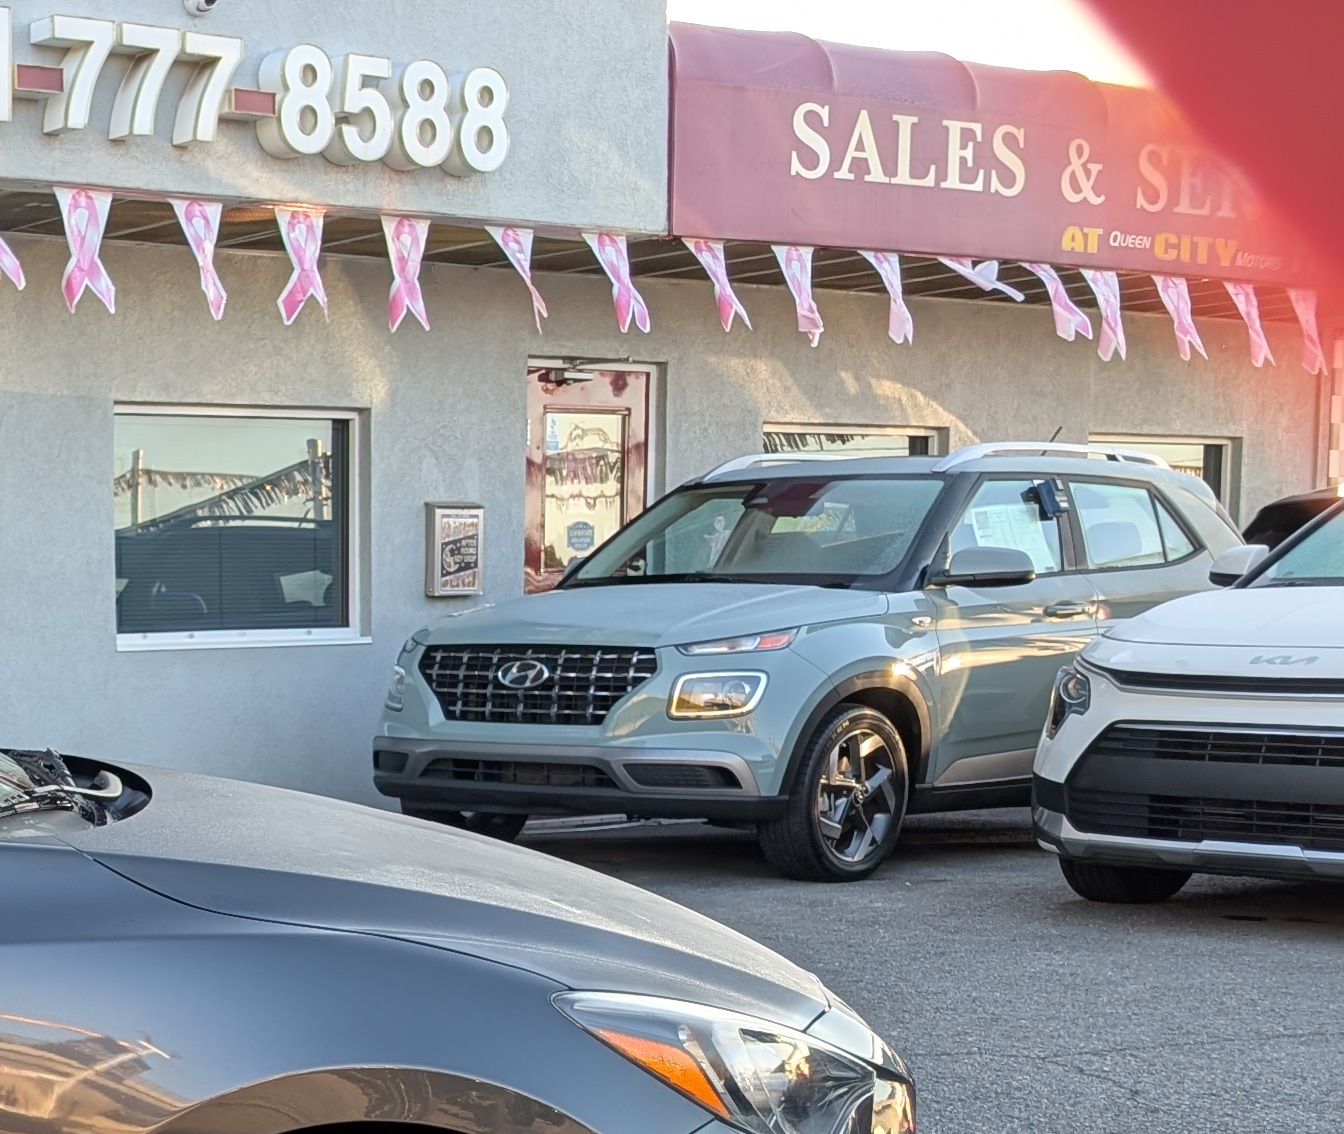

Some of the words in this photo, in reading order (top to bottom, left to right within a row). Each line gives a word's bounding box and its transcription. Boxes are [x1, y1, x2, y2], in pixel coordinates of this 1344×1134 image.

[790, 102, 1026, 197] SALES
[1060, 138, 1106, 206] &
[1061, 226, 1104, 254] AT
[1108, 230, 1152, 250] QUEEN
[1154, 232, 1238, 267] CITY
